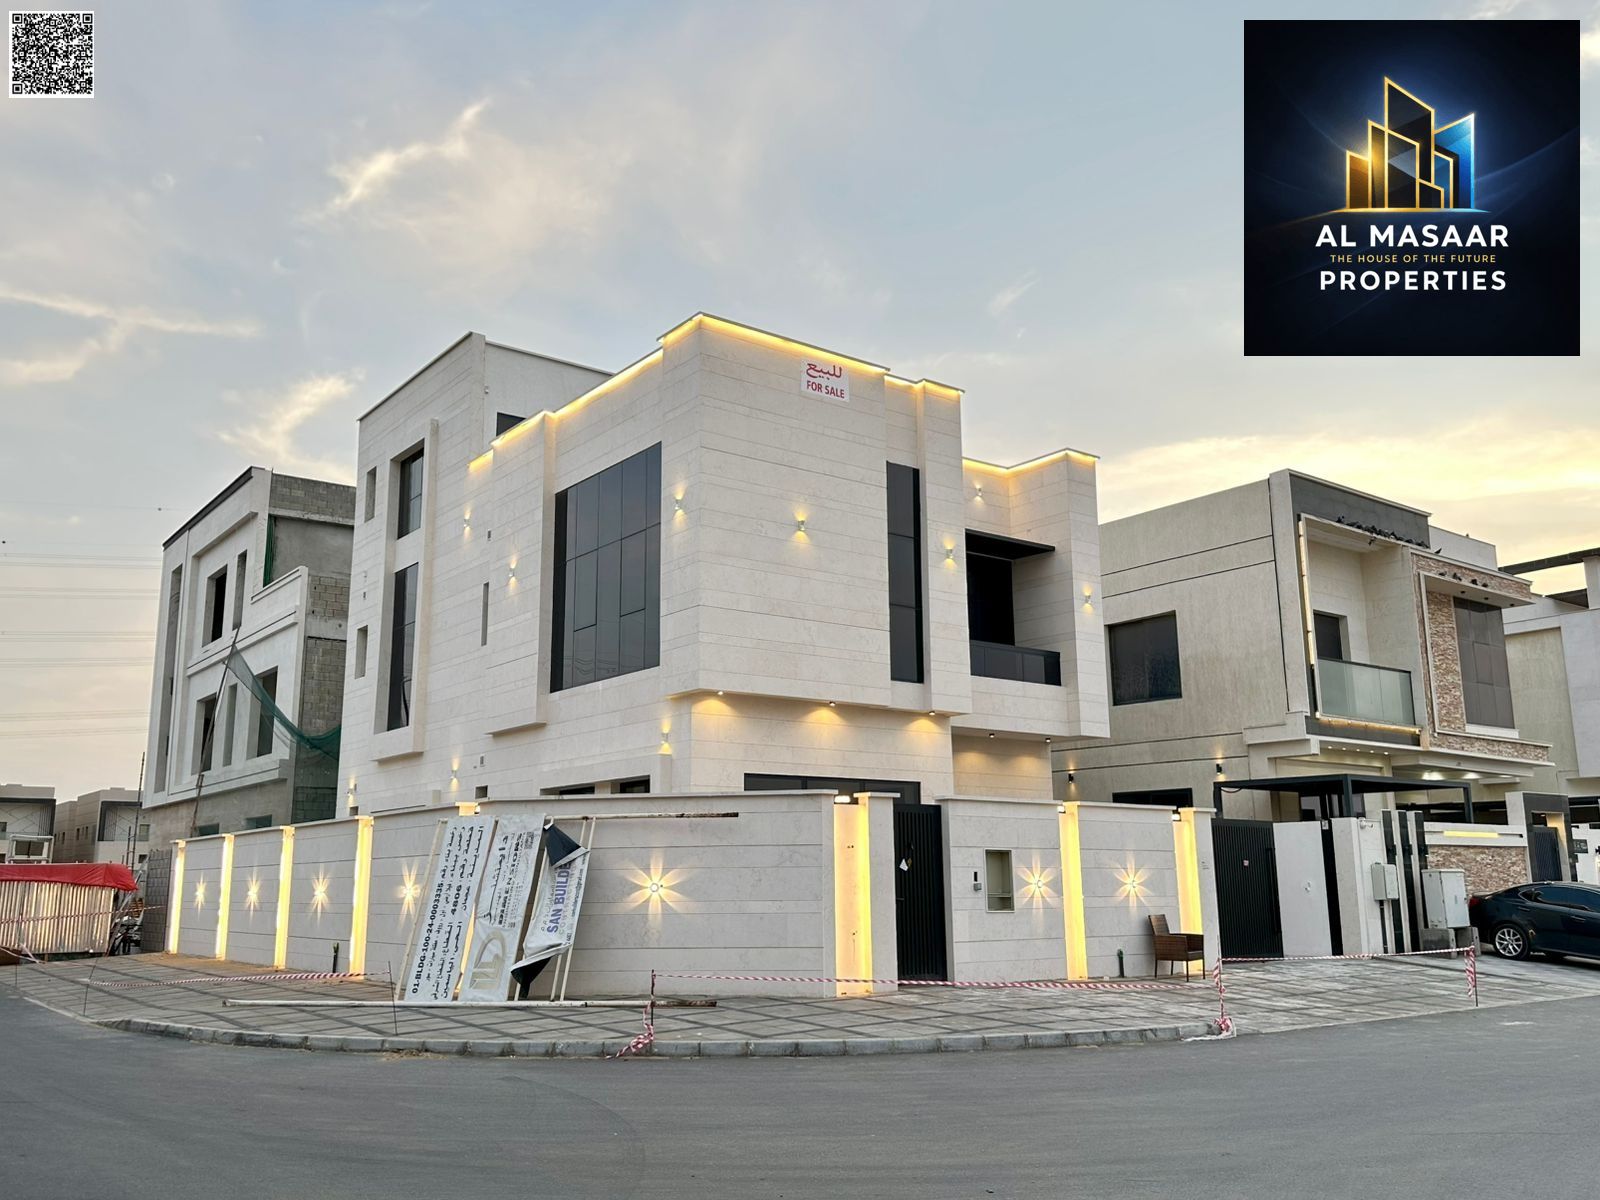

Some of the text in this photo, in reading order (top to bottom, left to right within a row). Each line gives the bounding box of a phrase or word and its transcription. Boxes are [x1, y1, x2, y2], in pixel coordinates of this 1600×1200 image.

[806, 363, 842, 380] للبيع
[807, 380, 845, 399] FOR SALE
[450, 883, 463, 916] 4806
[546, 908, 562, 933] SAN
